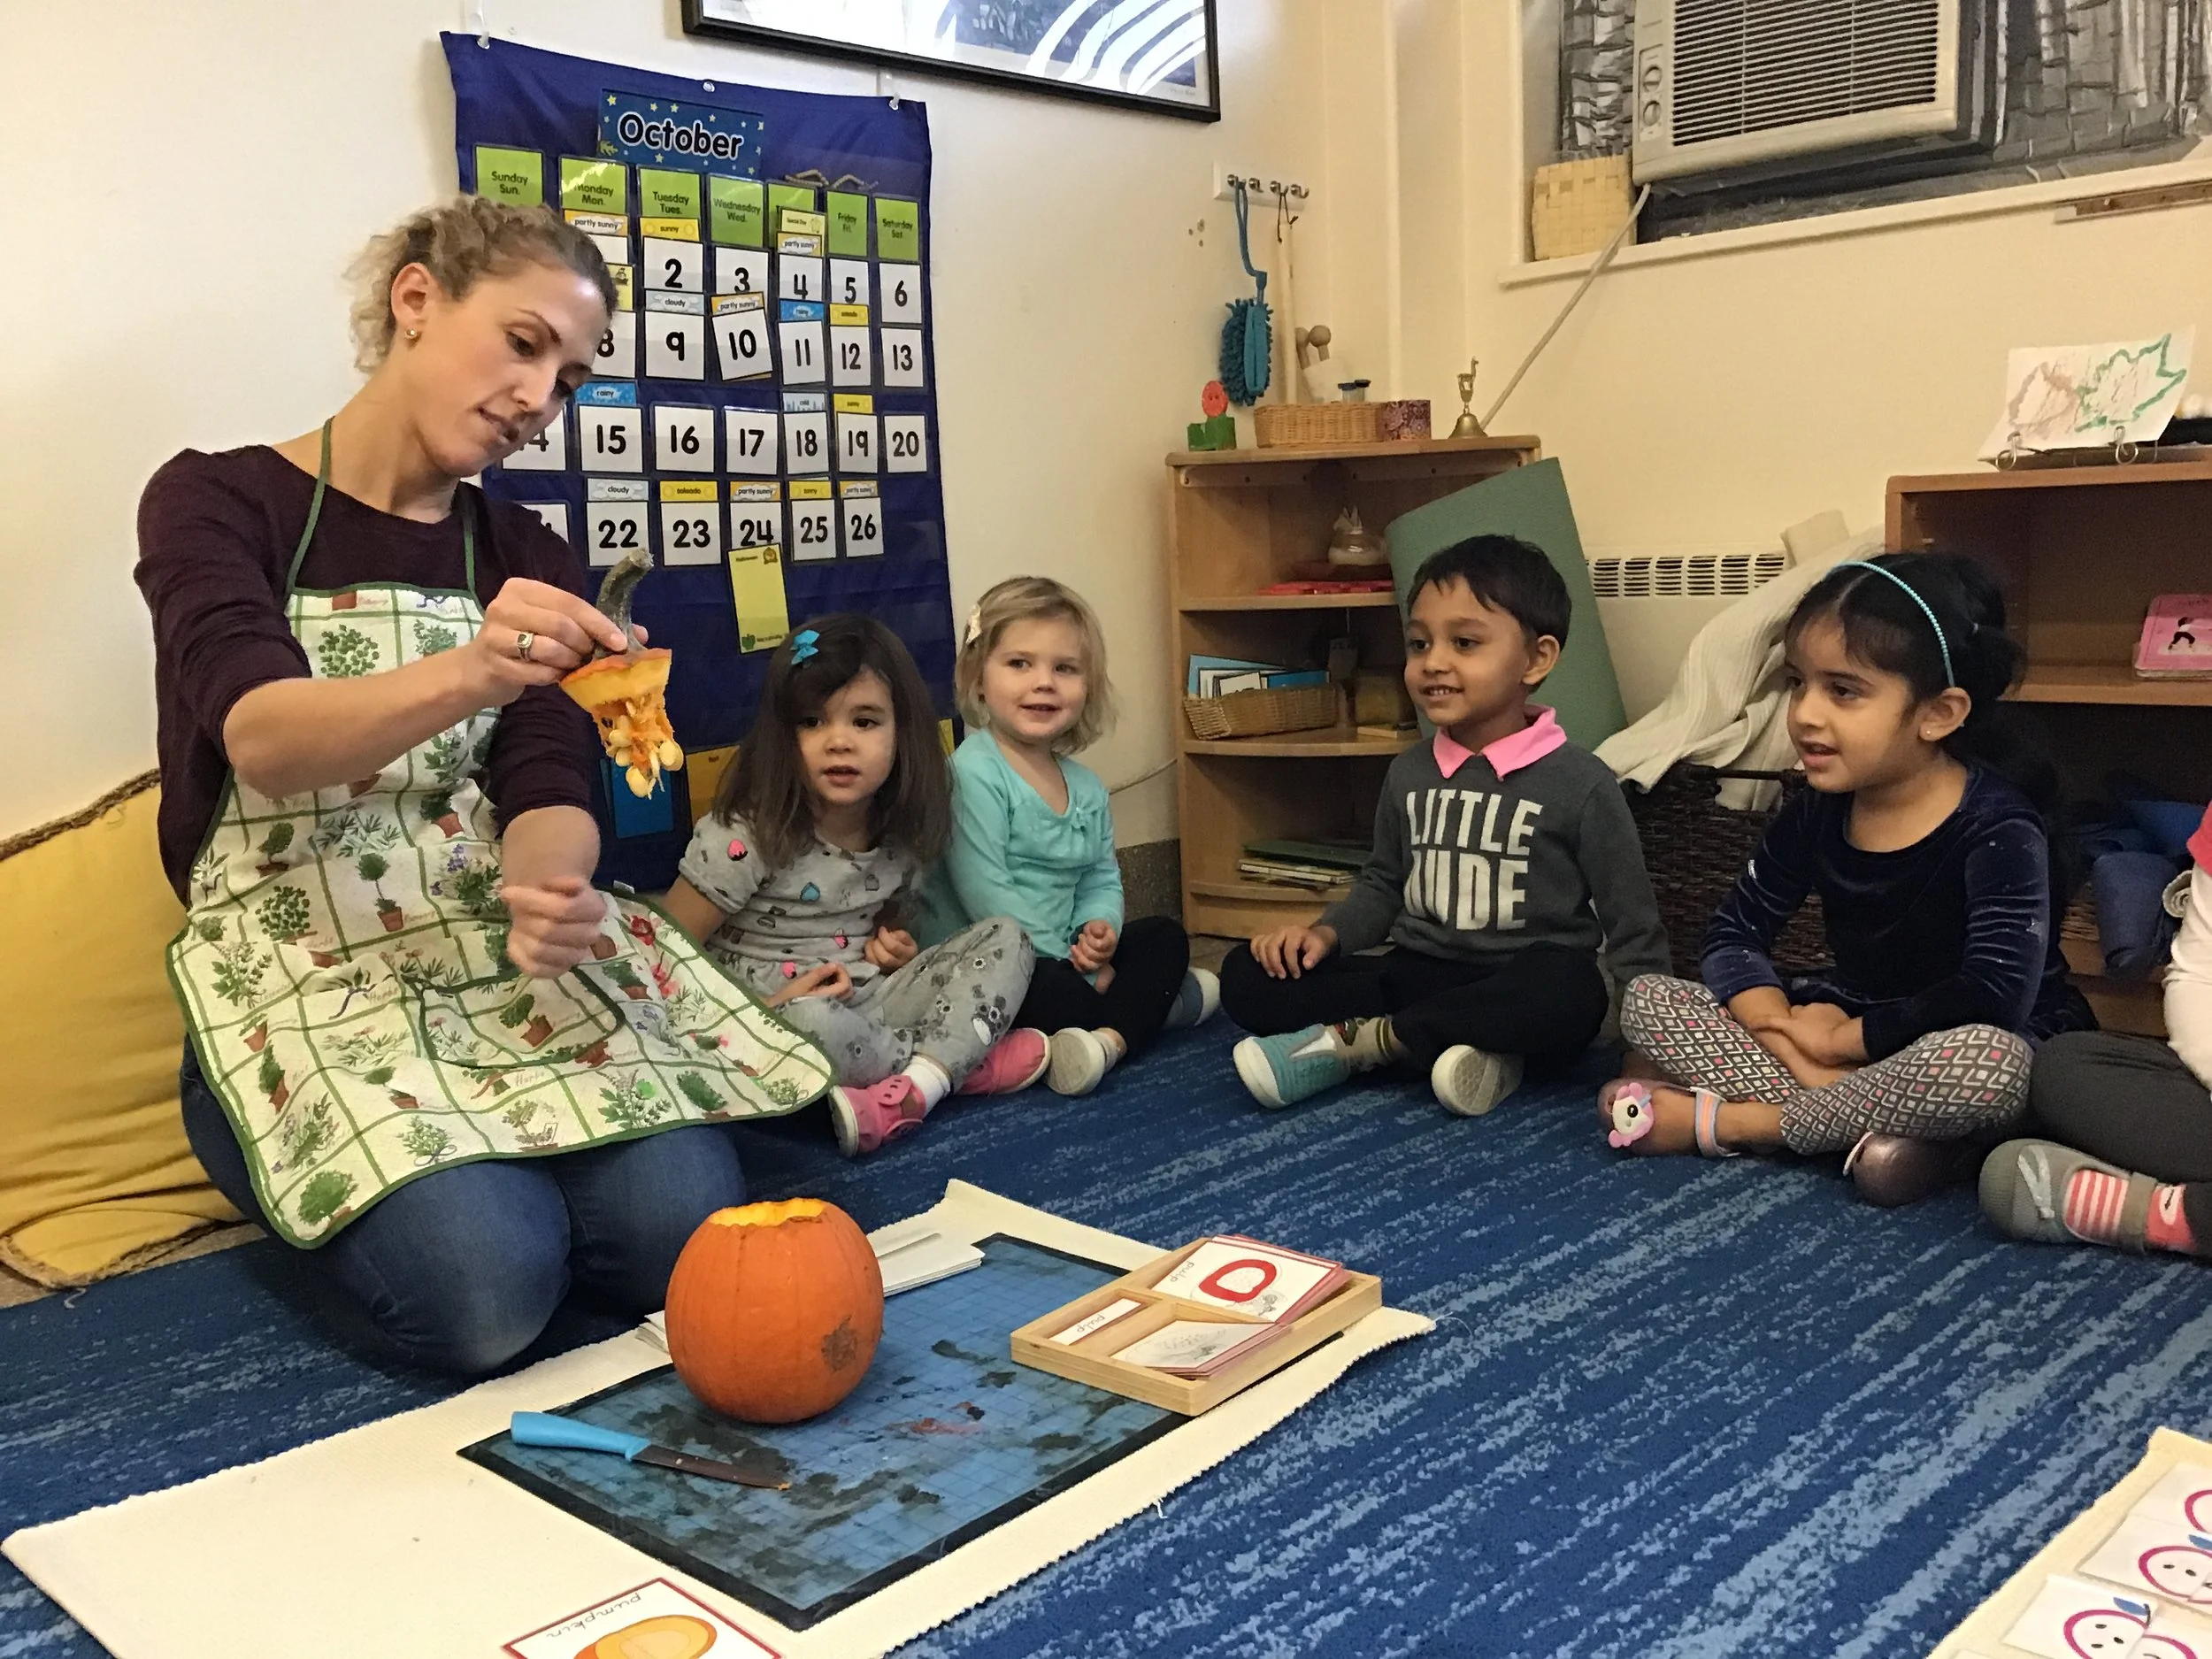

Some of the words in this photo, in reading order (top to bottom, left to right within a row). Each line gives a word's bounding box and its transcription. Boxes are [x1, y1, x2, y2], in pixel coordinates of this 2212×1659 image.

[618, 112, 743, 159] October
[491, 171, 528, 186] Sunday
[499, 184, 520, 196] Sun.
[652, 191, 689, 205] Tuesday
[659, 204, 682, 215] Tues.
[713, 198, 761, 216] Wednesday
[574, 219, 596, 228] partly
[597, 221, 618, 230] sunny
[838, 212, 856, 226] Friday
[882, 219, 913, 231] Saturday
[664, 258, 682, 288] 2
[733, 267, 750, 294] 3
[794, 273, 809, 299] 4
[844, 277, 856, 303] 5
[895, 280, 908, 307] 6
[719, 302, 737, 311] partly
[596, 328, 615, 357] 8
[666, 331, 685, 361] 9
[728, 329, 757, 360] 10
[795, 338, 810, 367] 11
[841, 342, 861, 370] 12
[893, 344, 913, 371] 13
[596, 424, 626, 454] 15
[671, 425, 700, 454] 16
[740, 428, 764, 457] 17
[796, 429, 818, 457] 18
[848, 430, 869, 457] 19
[892, 431, 919, 457] 20
[607, 486, 629, 495] cloudy
[598, 519, 639, 549] 22
[672, 519, 710, 548] 23
[740, 518, 774, 547] 24
[800, 516, 828, 543] 25
[851, 513, 876, 541] 26
[1406, 788, 1543, 856] LITTLE
[1170, 1261, 1194, 1282] pulp
[1077, 1313, 1105, 1333] pulp
[546, 1593, 641, 1638] pumpkin
